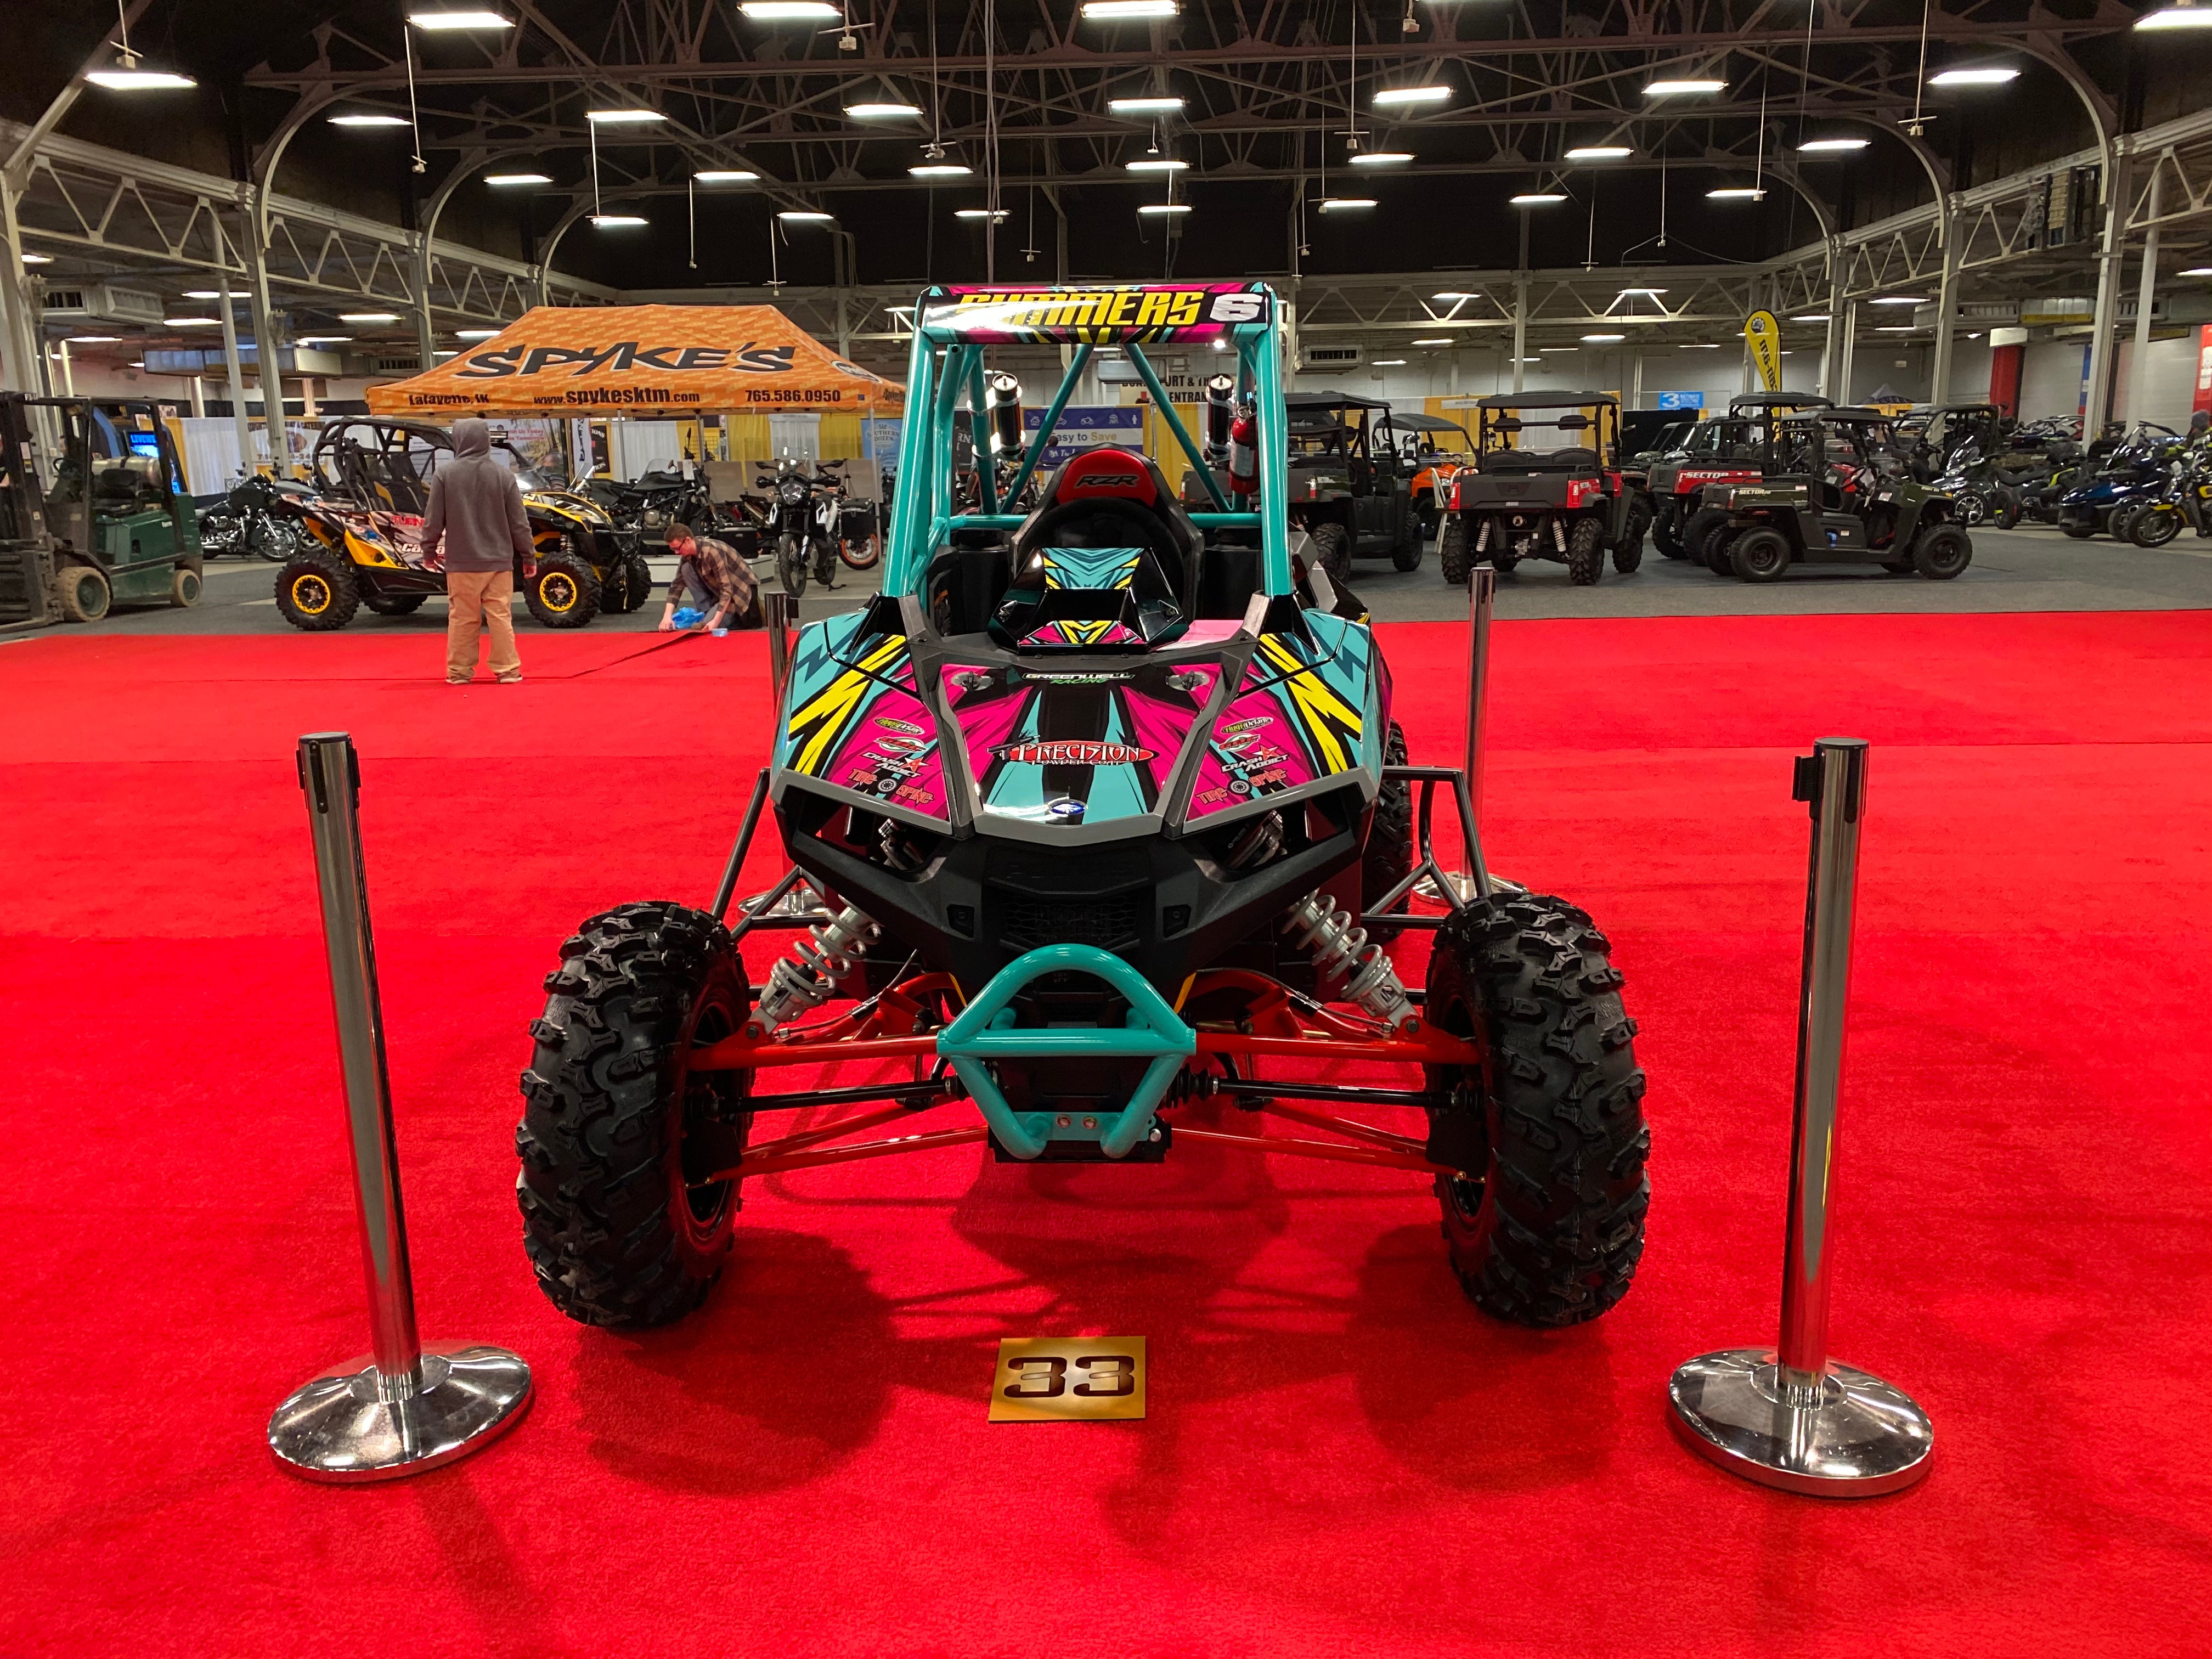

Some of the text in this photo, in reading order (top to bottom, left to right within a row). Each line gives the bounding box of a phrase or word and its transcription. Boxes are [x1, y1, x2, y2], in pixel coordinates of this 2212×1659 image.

[955, 292, 1263, 325] MMERS 6
[533, 387, 700, 405] www.spykesktm.com
[745, 390, 841, 402] 765.586.0950
[1169, 392, 1206, 403] ENTRAN
[1661, 392, 1680, 408] 3
[1051, 432, 1117, 443] asy to Save
[1074, 474, 1139, 489] RZR
[862, 752, 904, 766] CRASH
[1017, 743, 1141, 761] PRECISION
[874, 762, 922, 778] ADDICT
[1221, 755, 1262, 772] CRASH
[1245, 754, 1289, 772] ADDICT
[1003, 1355, 1135, 1398] 33
